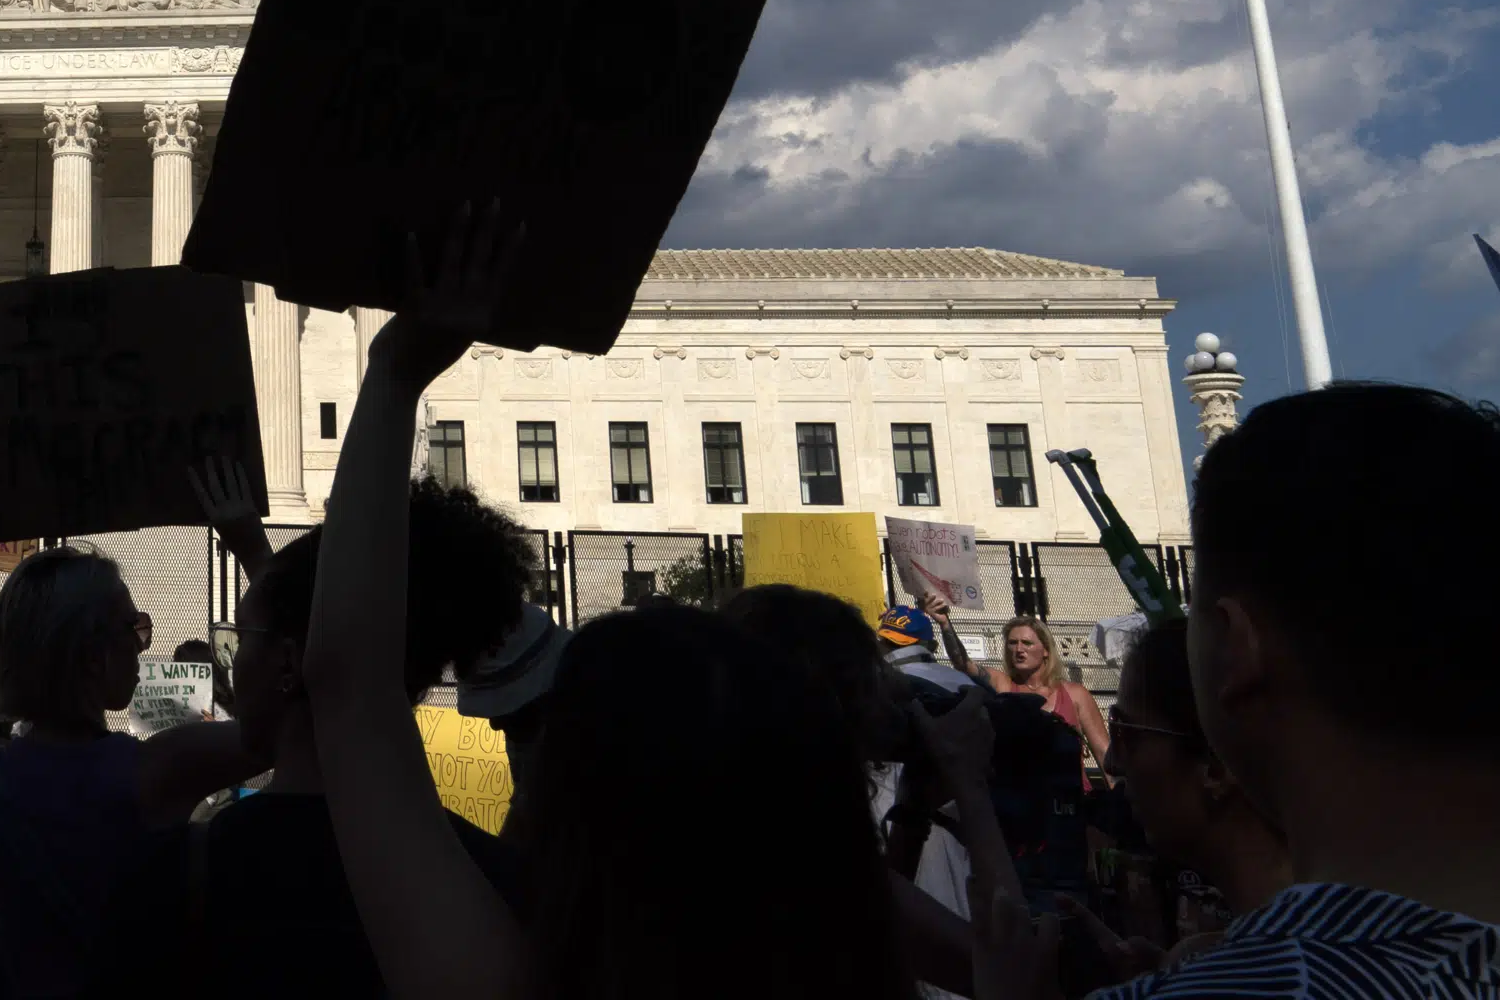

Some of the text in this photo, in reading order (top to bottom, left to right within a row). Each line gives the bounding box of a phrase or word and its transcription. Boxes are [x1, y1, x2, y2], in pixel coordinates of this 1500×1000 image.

[42, 53, 109, 70] UNDER
[118, 52, 158, 68] LAW
[778, 518, 785, 552] I
[799, 519, 857, 551] MAKE
[915, 523, 957, 541] robots
[831, 553, 841, 569] A
[145, 663, 211, 681] I WANTED
[183, 685, 196, 695] IN
[182, 697, 190, 710] I
